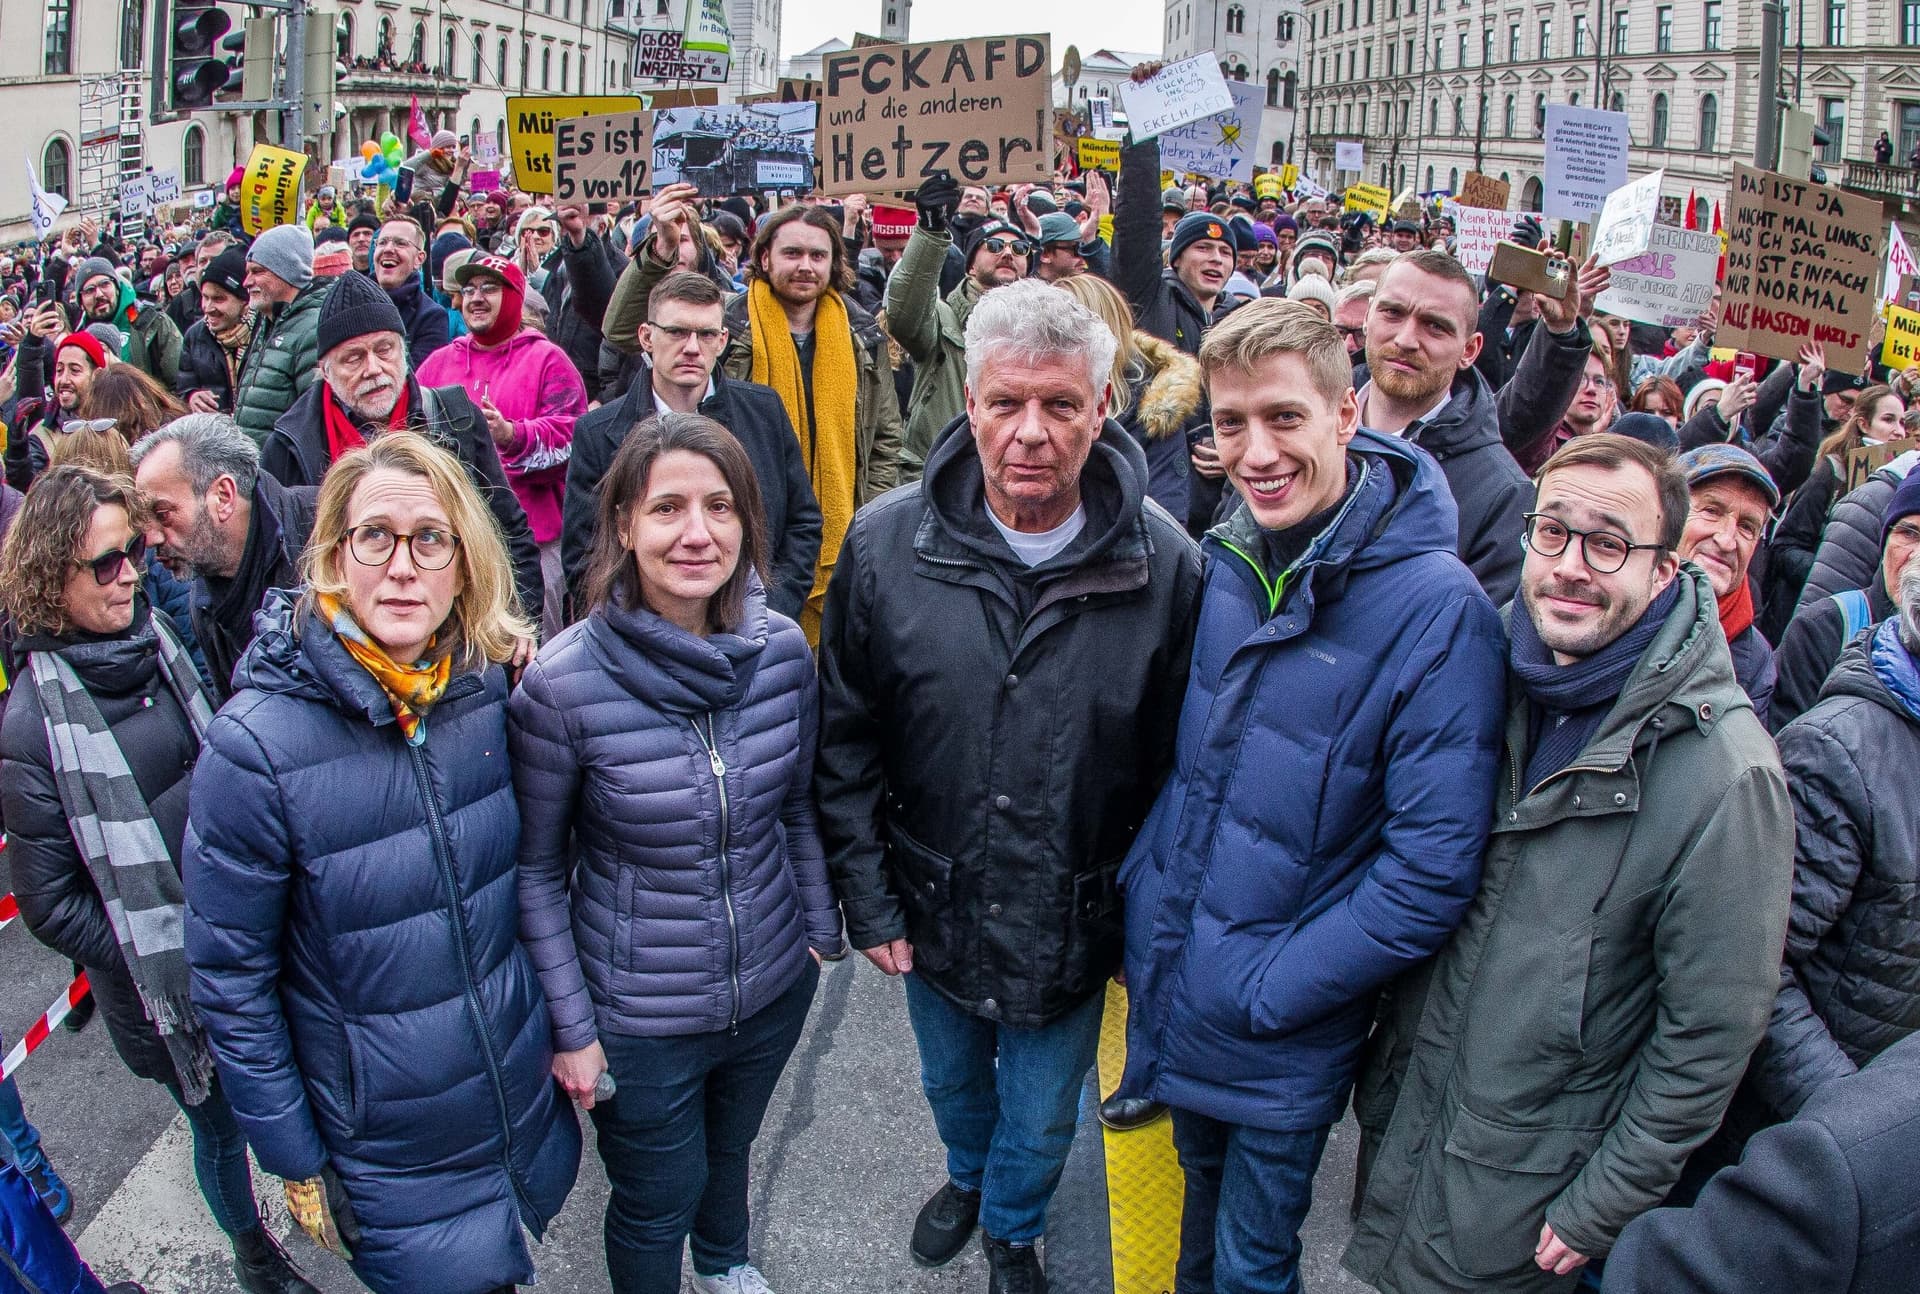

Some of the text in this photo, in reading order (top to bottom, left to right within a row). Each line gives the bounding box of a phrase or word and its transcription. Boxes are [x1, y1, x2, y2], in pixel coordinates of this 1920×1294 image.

[700, 23, 708, 32] in
[658, 32, 683, 46] OST
[642, 48, 686, 62] NIEDER
[688, 54, 701, 64] mit
[640, 62, 706, 79] NAZIPEST
[828, 46, 930, 97] FCK
[942, 38, 1045, 83] AFD
[1156, 78, 1185, 94] EUCH
[1166, 88, 1182, 98] INS
[830, 88, 1002, 127] und die anderen
[1231, 94, 1248, 106] er
[1562, 120, 1612, 132] Wenn RECHTE
[557, 117, 644, 158] Es ist
[832, 109, 1044, 183] Hetzer!
[1566, 138, 1597, 148] Mehrheit
[1598, 143, 1621, 152] dieses
[1598, 134, 1620, 142] wären
[524, 150, 552, 174] ist
[1084, 155, 1092, 163] ist
[1566, 156, 1584, 164] nicht
[1584, 150, 1606, 159] haben
[256, 158, 274, 180] ist
[1187, 161, 1202, 172] es
[1566, 164, 1606, 176] Geschichte
[122, 175, 175, 196] Kein Bier
[558, 162, 576, 200] 5
[583, 177, 622, 198] vor
[1473, 177, 1501, 189] ALLE
[126, 185, 178, 213] für Nazis!
[274, 158, 296, 224] Münche
[1464, 184, 1505, 205] HASSEN
[1558, 189, 1570, 197] NIE
[1571, 192, 1599, 201] WIEDER
[1740, 174, 1844, 218] DAS IST JA
[1348, 192, 1384, 209] München
[1459, 208, 1486, 224] Keine
[1487, 211, 1512, 226] Ruhe
[1460, 226, 1488, 239] rechte
[1652, 227, 1718, 254] MEINER
[1738, 208, 1876, 256] NICHT MAL LINKS,
[1460, 240, 1478, 250] und
[1731, 227, 1752, 246] WAS
[1757, 232, 1783, 251] ICH
[1792, 238, 1827, 260] SAG
[1460, 254, 1489, 271] Unter
[1730, 252, 1870, 294] DAS IST EINFACH
[1726, 274, 1849, 315] NUR NORMAL
[1722, 302, 1750, 330] ALLE
[1752, 305, 1810, 336] HASSEN
[1814, 323, 1862, 350] NAZIS
[1893, 340, 1911, 358] ist
